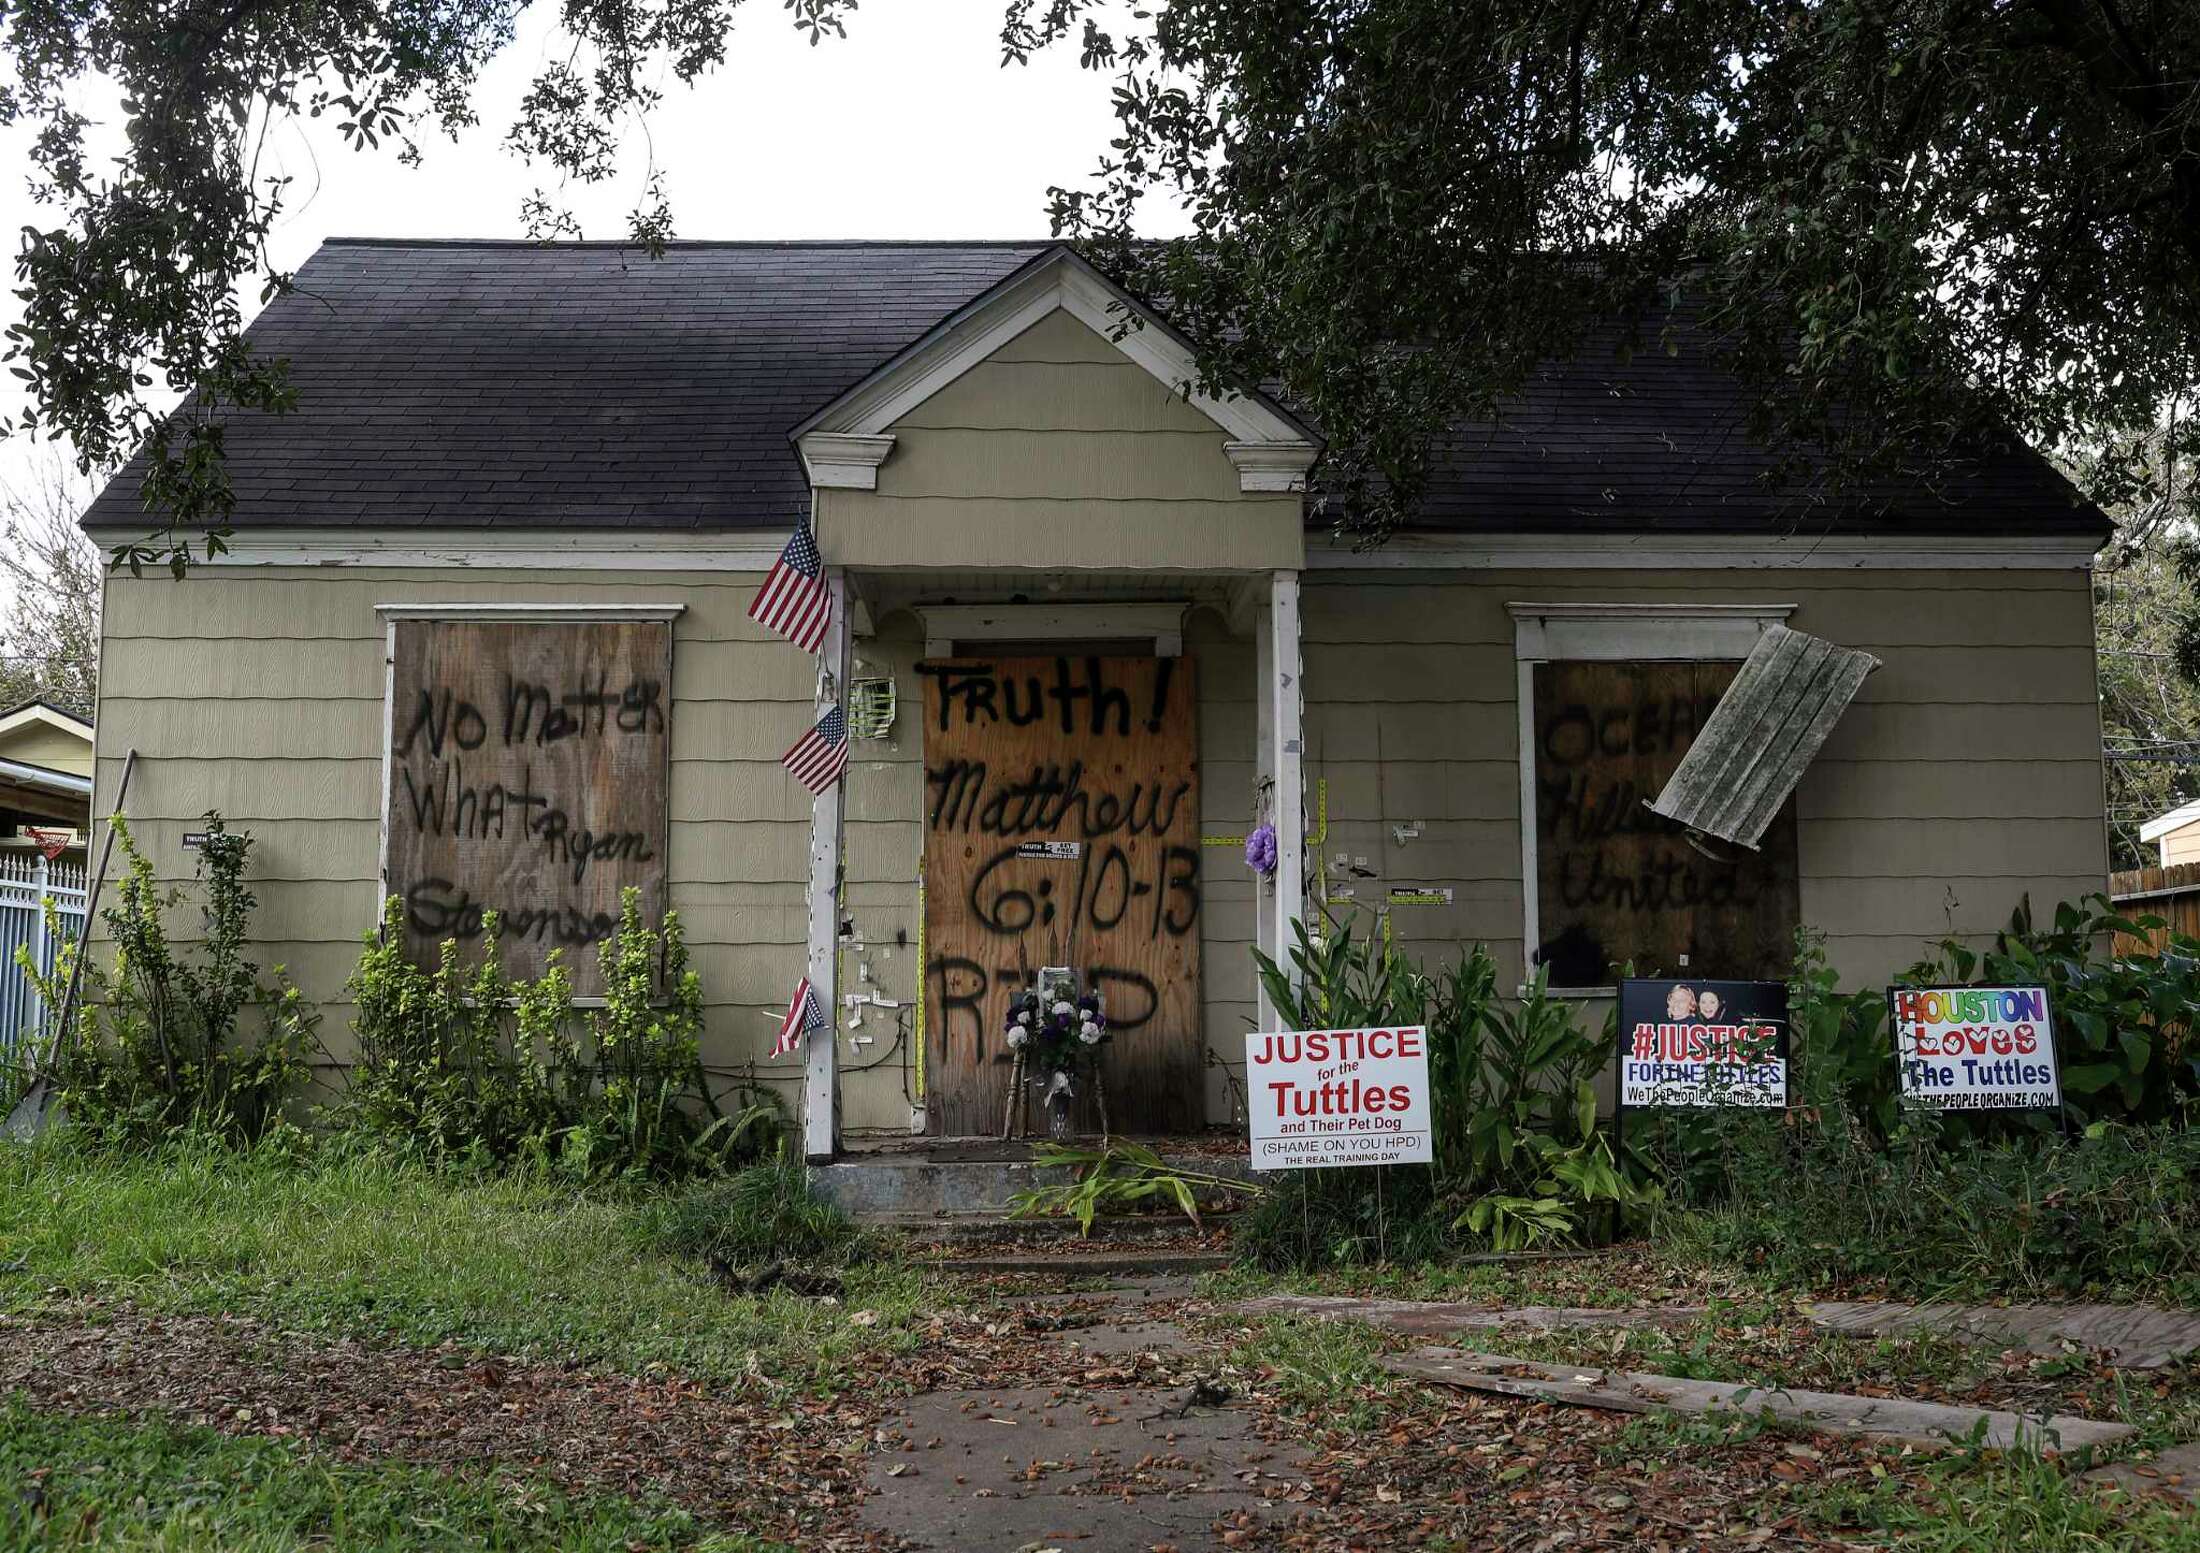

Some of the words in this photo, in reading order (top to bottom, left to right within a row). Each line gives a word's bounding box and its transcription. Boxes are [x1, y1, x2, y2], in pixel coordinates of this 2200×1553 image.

[396, 688, 487, 758] No
[929, 758, 1190, 837] Matthew
[531, 810, 654, 885] Ryan
[972, 842, 1199, 940] 6:10-13
[1898, 990, 2044, 1024] HOUSTON
[1254, 1029, 1421, 1065] JUSTICE
[1317, 1067, 1335, 1081] for
[1339, 1061, 1359, 1075] the
[1908, 1058, 1954, 1087] The
[1961, 1058, 2052, 1086] Tuttles
[1268, 1078, 1411, 1117] Tuttles
[1280, 1120, 1306, 1134] and
[1310, 1118, 1345, 1132] Their
[1348, 1117, 1371, 1131] Pet
[1374, 1117, 1402, 1131] Dog
[1262, 1139, 1319, 1156] (SHAME
[1323, 1139, 1346, 1152] ON
[1349, 1137, 1381, 1151] YOU
[1385, 1135, 1422, 1149] HPD)
[1284, 1156, 1303, 1165] THE
[1305, 1155, 1331, 1165] REAL
[1333, 1153, 1379, 1163] TRAINING
[1381, 1152, 1400, 1162] DAY
